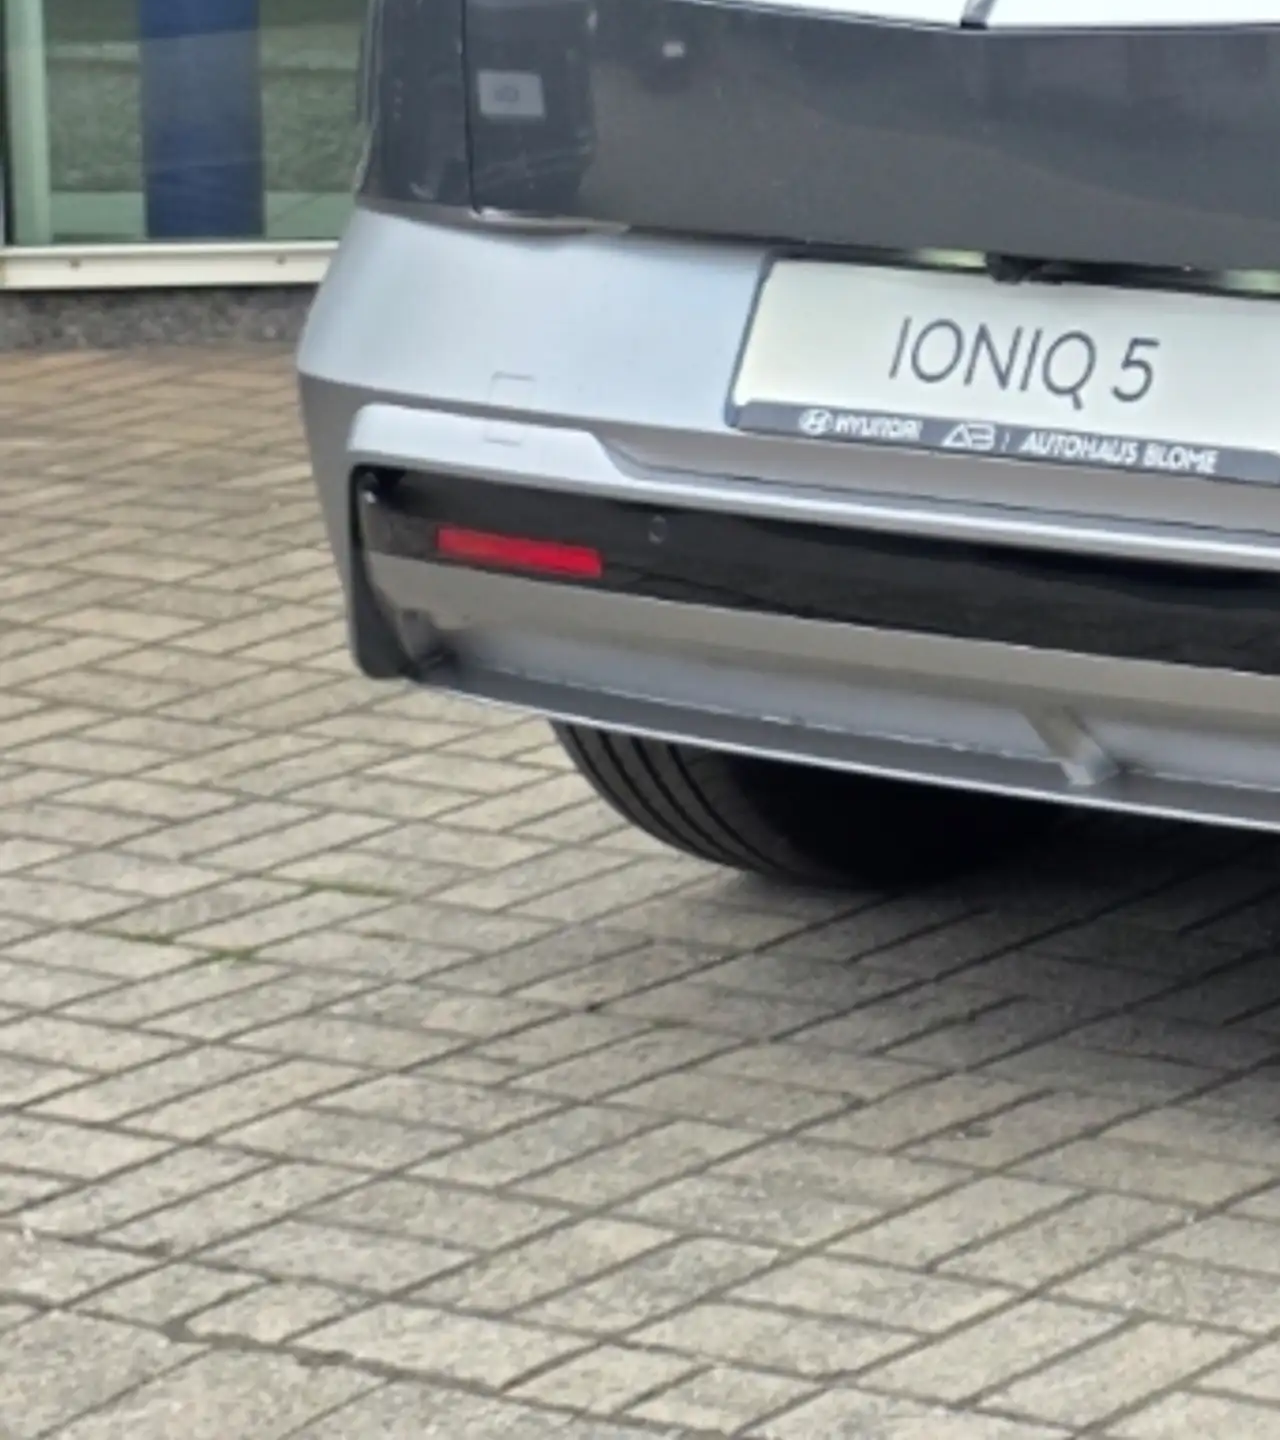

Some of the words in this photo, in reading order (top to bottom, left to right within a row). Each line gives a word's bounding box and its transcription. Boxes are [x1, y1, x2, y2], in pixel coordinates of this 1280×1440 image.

[888, 316, 1097, 410] IONIQ
[1110, 337, 1160, 403] 5
[1020, 430, 1140, 466] AUTOHAUS
[1142, 441, 1220, 475] BLOME
